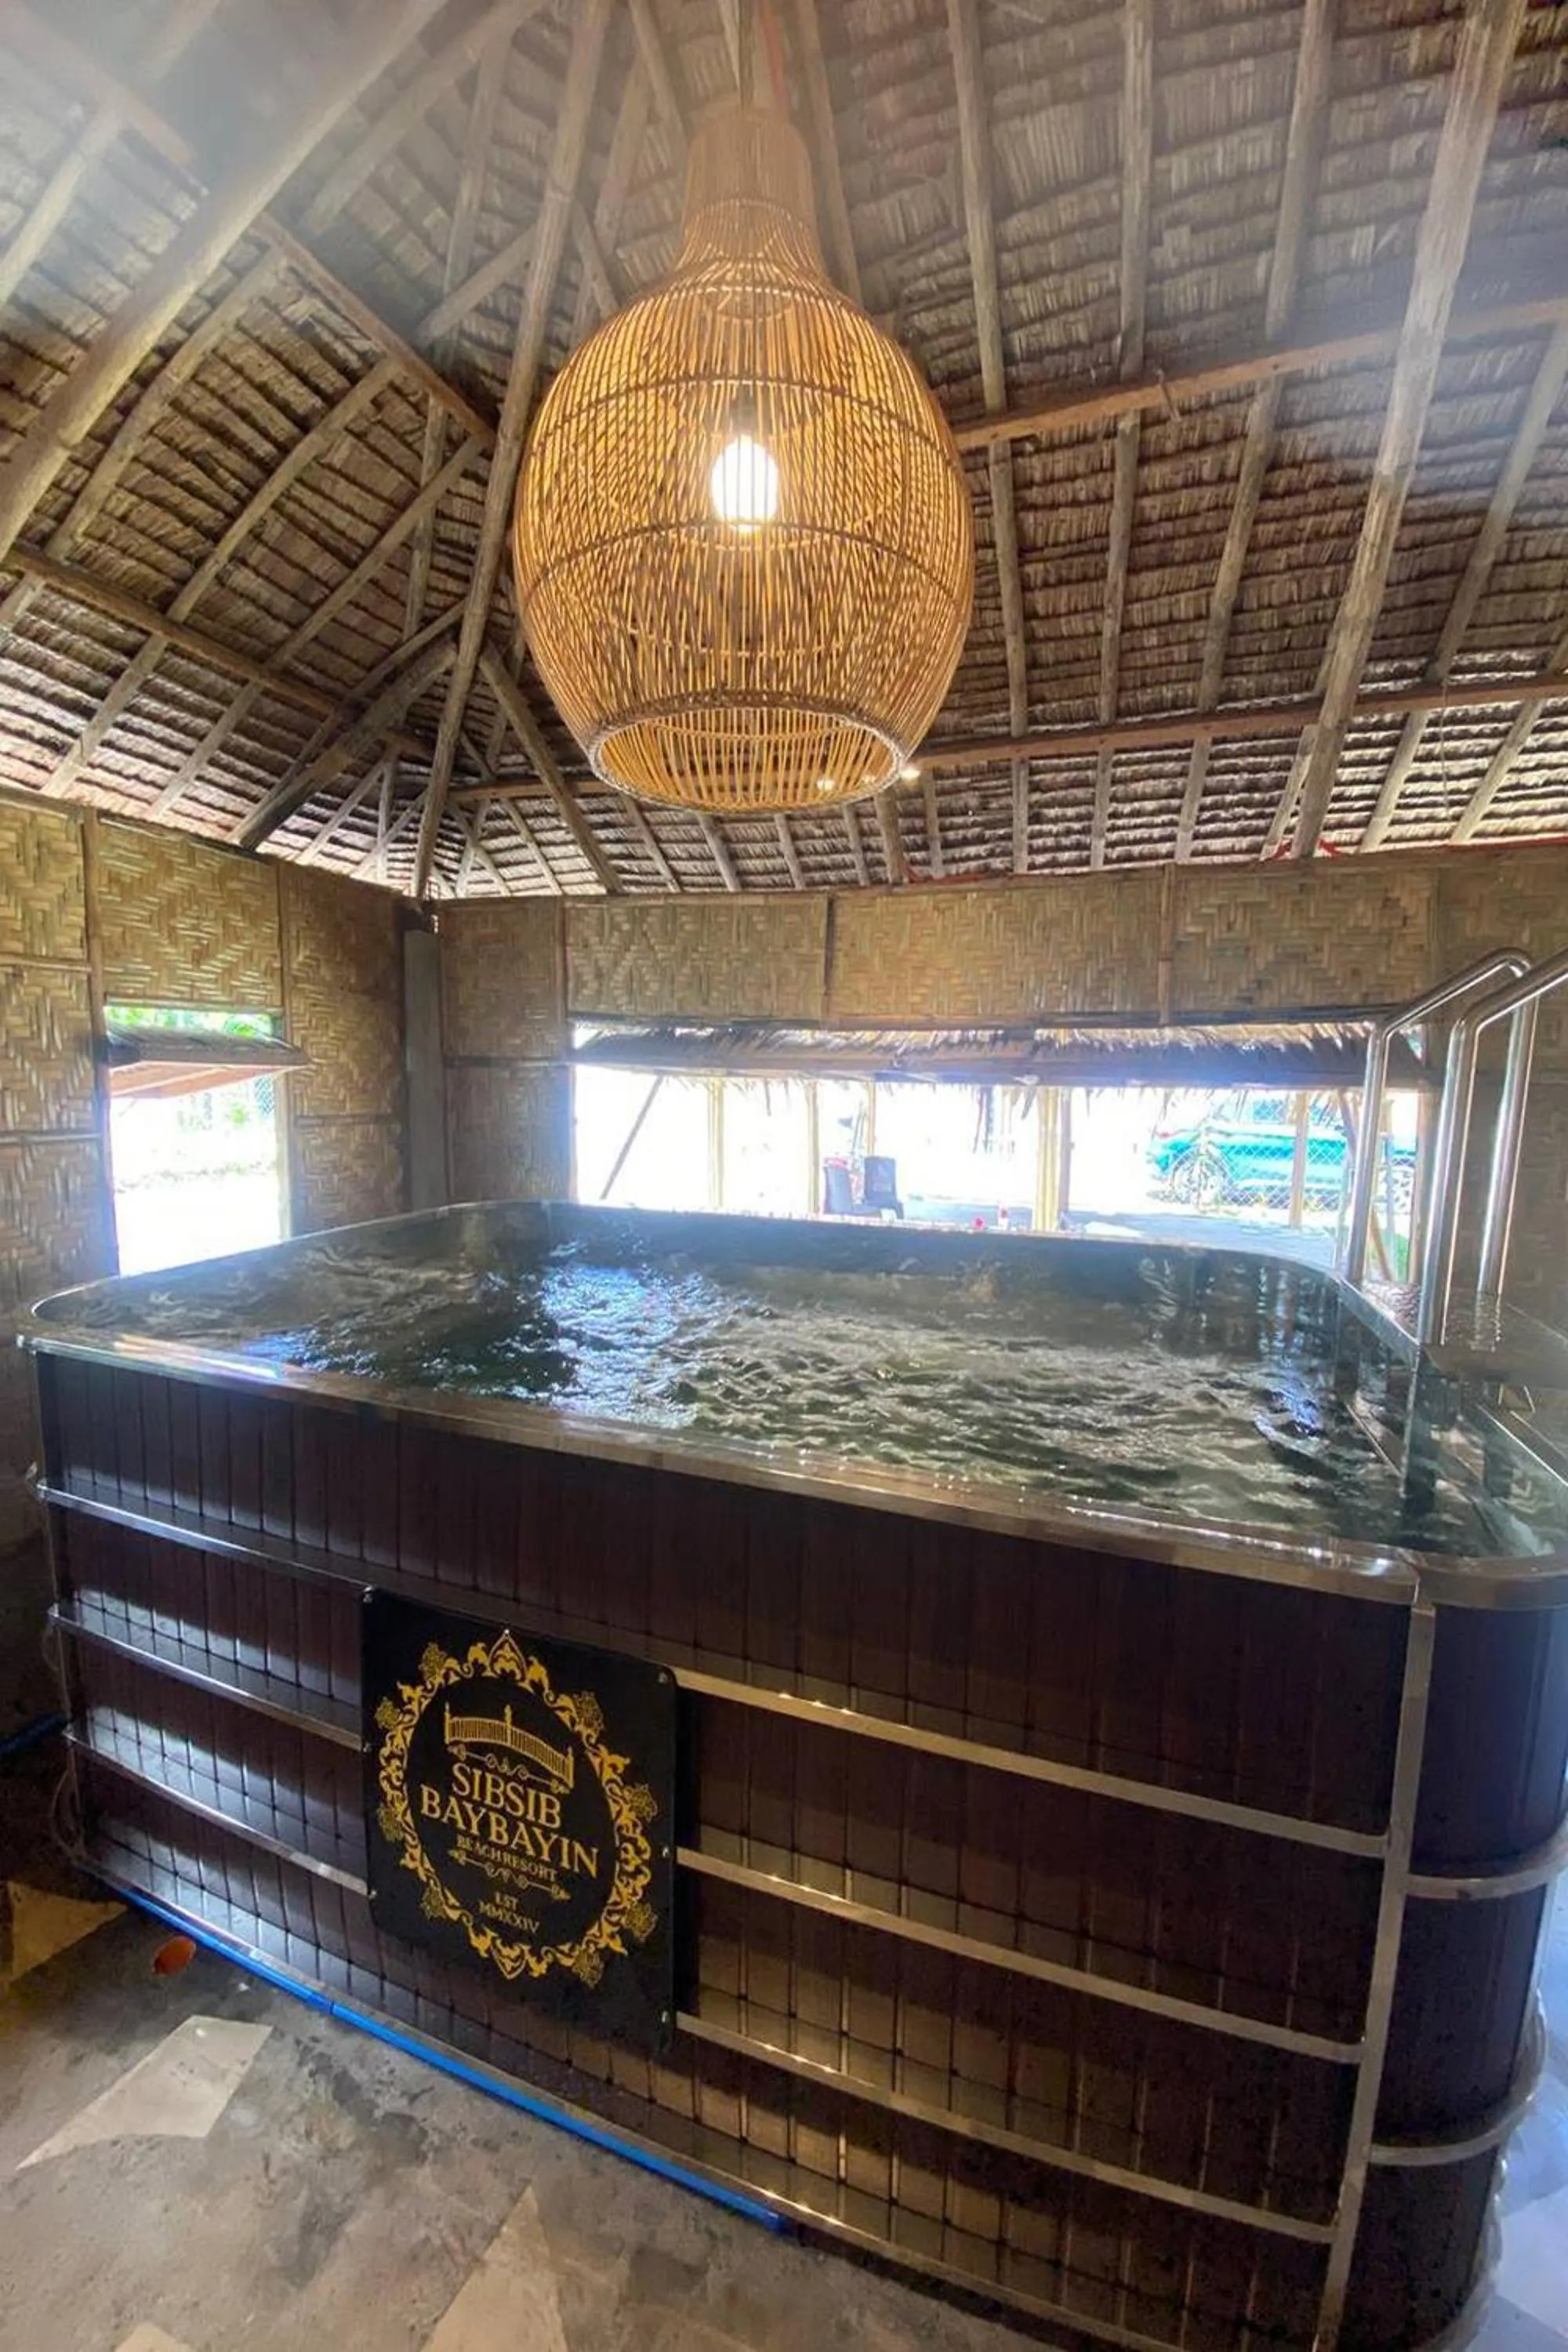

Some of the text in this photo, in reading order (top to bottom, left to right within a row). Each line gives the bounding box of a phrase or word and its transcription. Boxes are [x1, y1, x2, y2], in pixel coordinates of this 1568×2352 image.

[452, 1762, 561, 1829] SIBSIB
[420, 1784, 600, 1878] BAYBAYIN
[457, 1834, 557, 1882] BEACH RESORT
